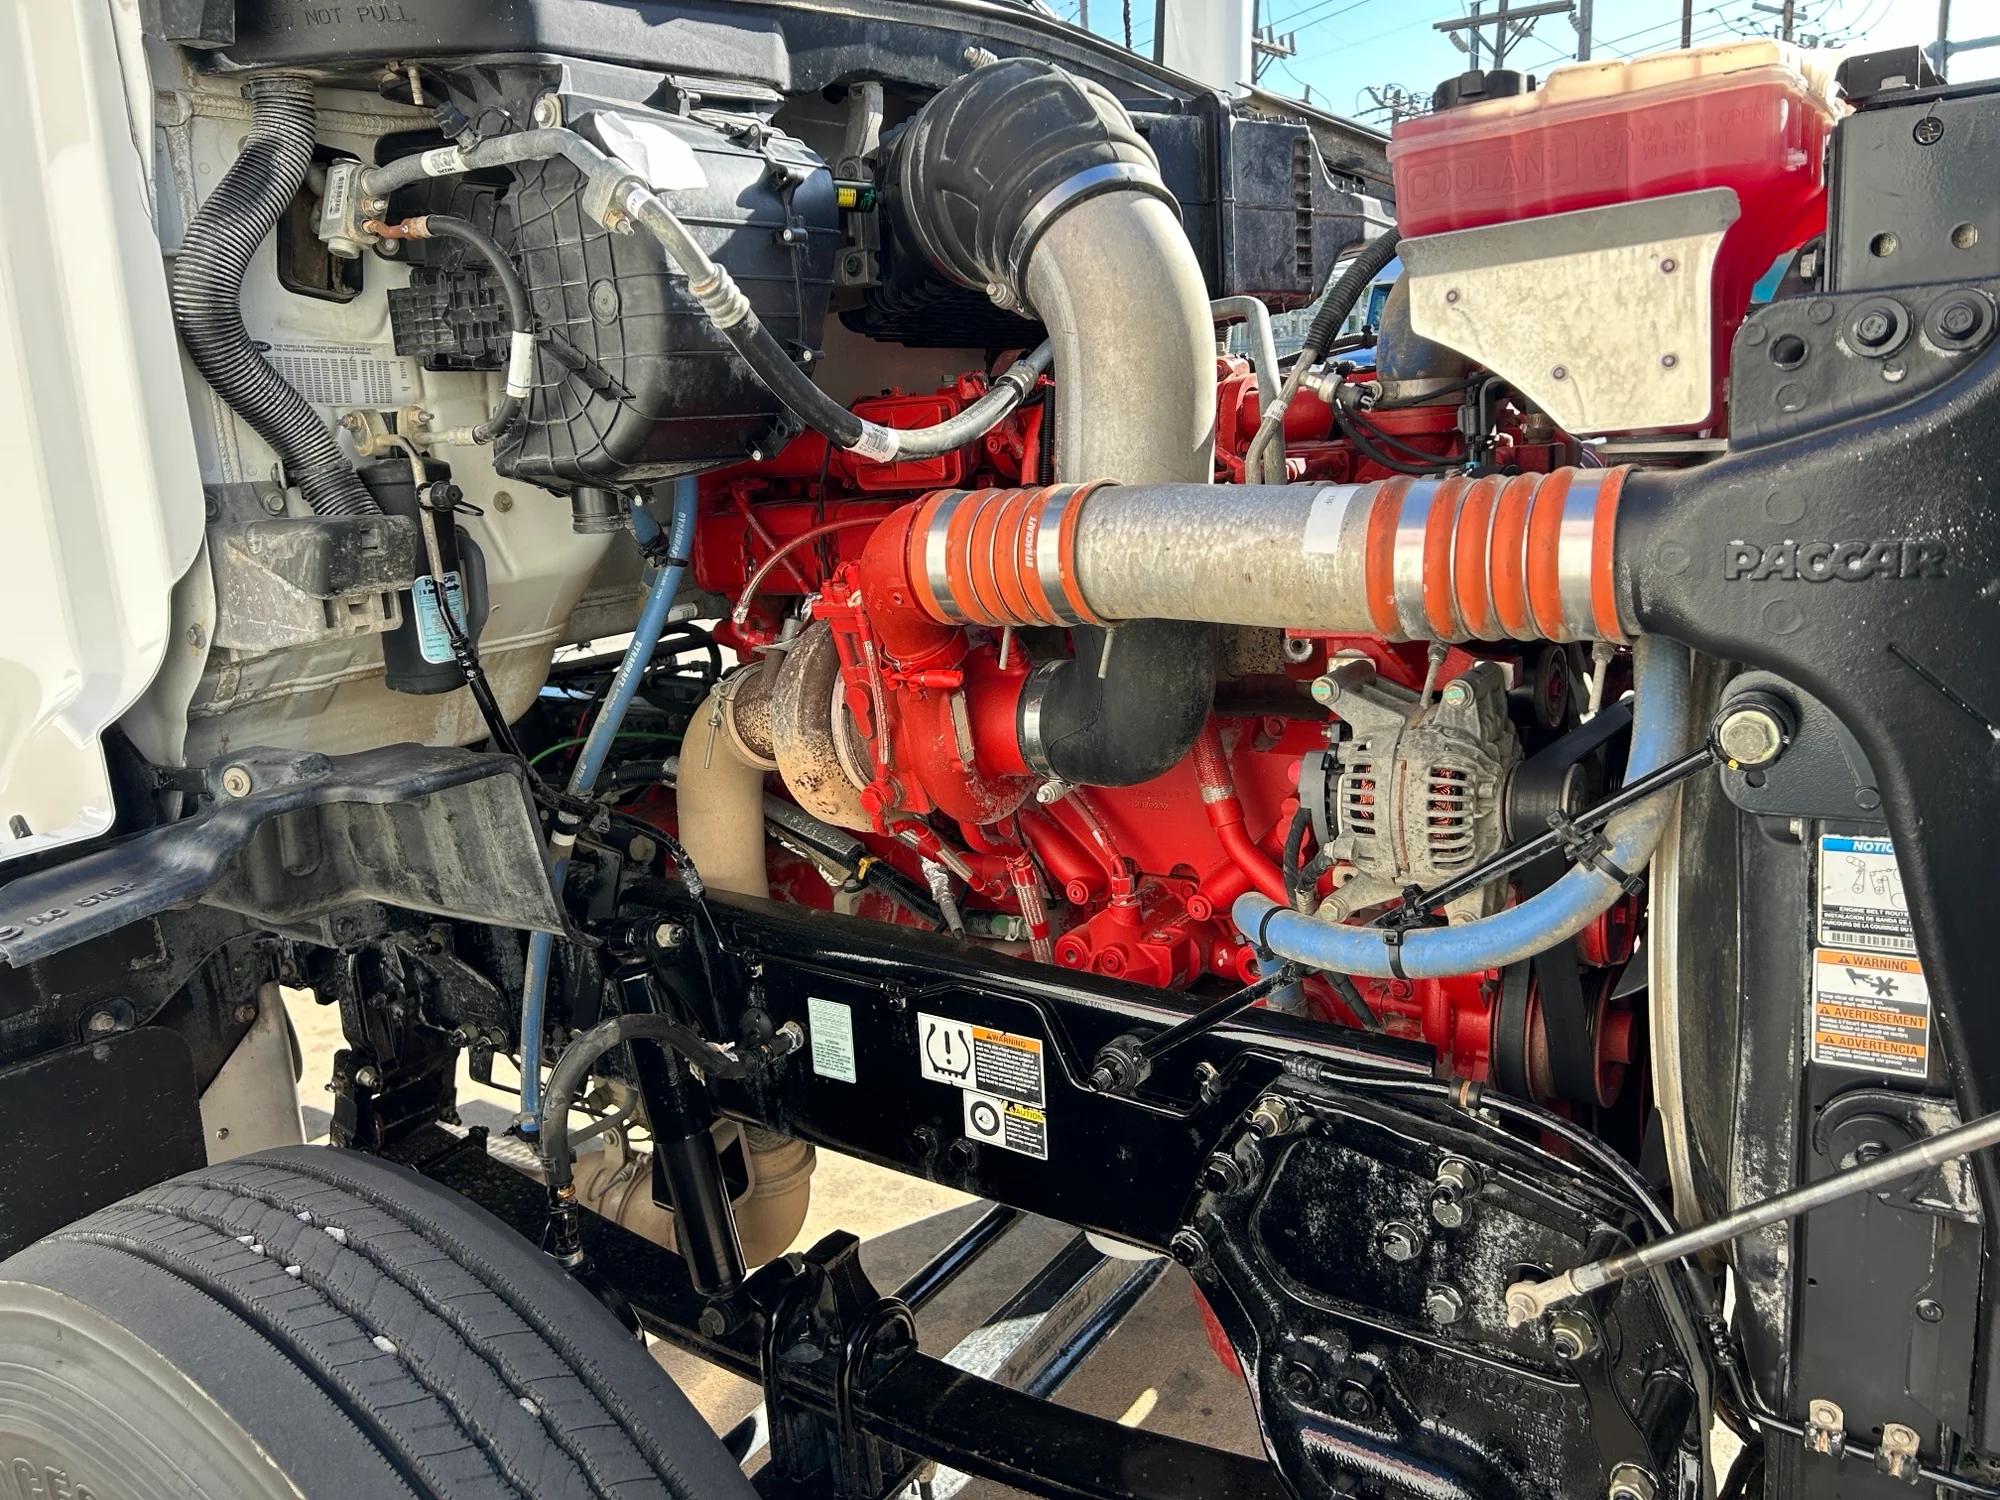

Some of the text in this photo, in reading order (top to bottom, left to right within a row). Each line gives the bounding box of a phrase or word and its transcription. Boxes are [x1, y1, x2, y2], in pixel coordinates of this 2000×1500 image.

[304, 8, 342, 26] NOT
[1642, 106, 1765, 140] DO NOT OPEN
[1643, 138, 1687, 161] WHEN
[1410, 148, 1563, 201] COOLANT
[1724, 540, 1949, 583] PACCAR
[618, 640, 643, 688] DYNACRAFT
[1852, 841, 1895, 853] NOTIC
[1875, 916, 1897, 924] BANDA
[1853, 956, 1908, 971] WARNING
[1835, 1007, 1924, 1027] AVERTISSEMENT
[992, 1034, 1026, 1048] WARNING
[1839, 1037, 1918, 1056] ADVERTENCIA
